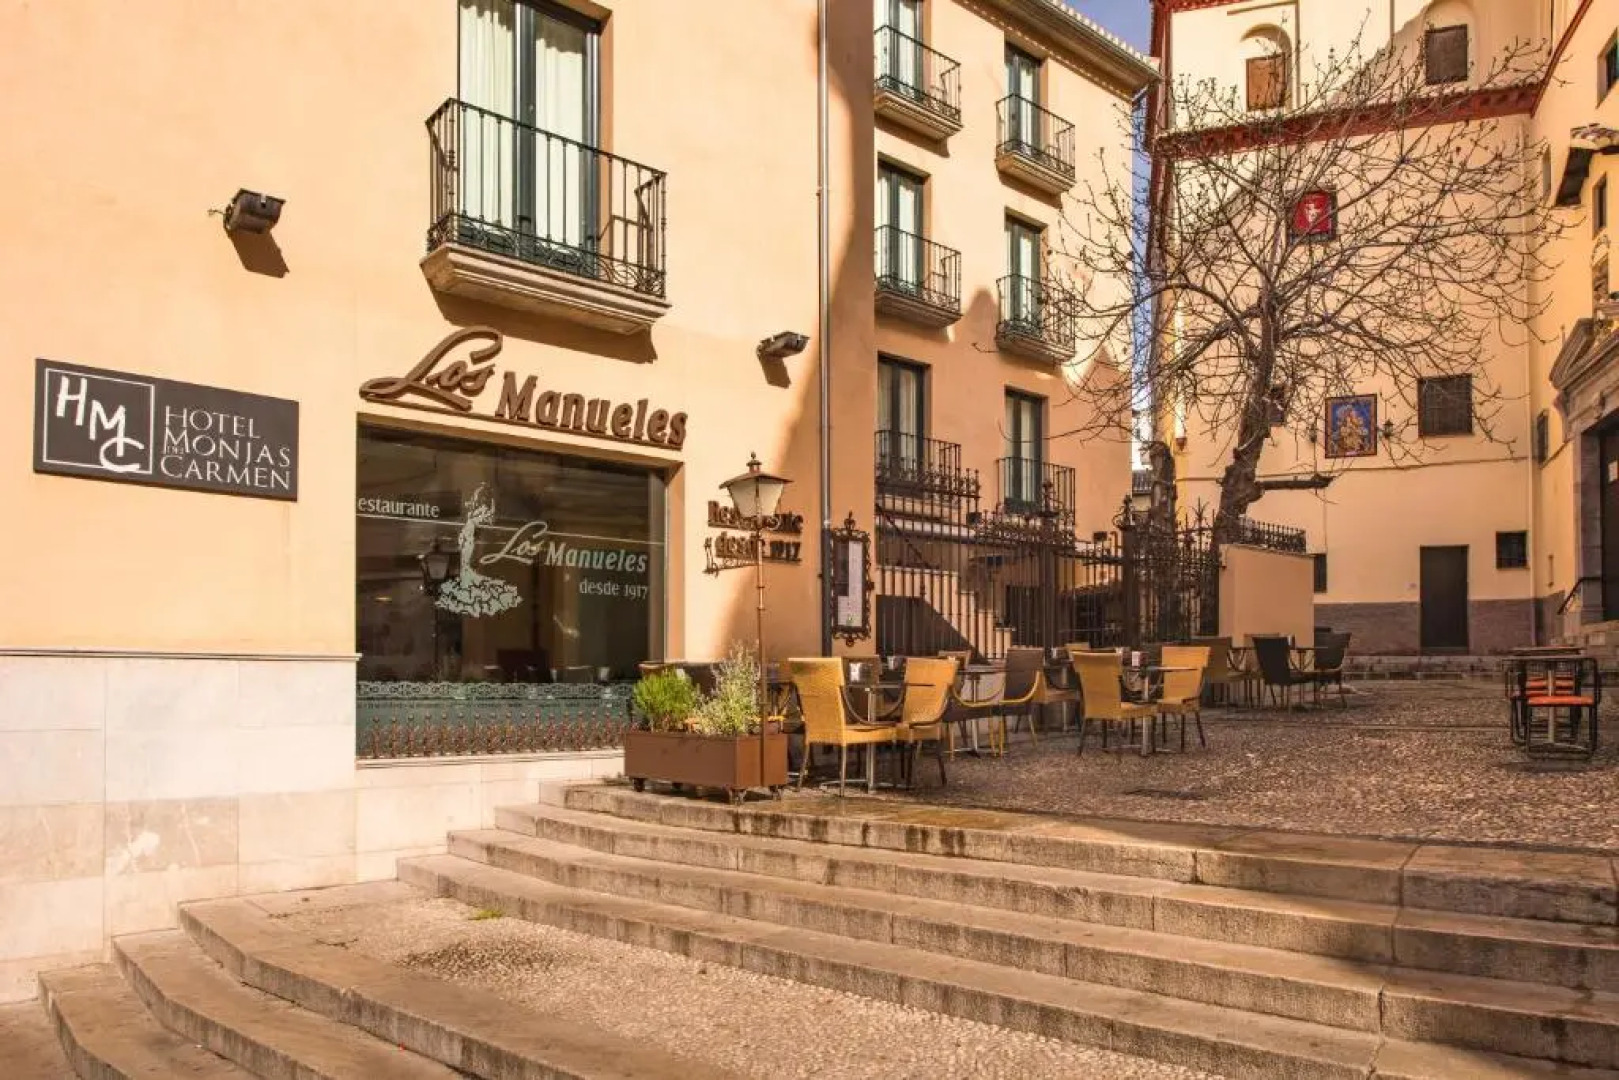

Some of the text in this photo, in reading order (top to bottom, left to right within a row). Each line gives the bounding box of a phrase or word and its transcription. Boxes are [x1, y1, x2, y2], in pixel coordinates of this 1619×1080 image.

[359, 325, 688, 446] Los Manueles
[56, 375, 145, 473] HMC
[165, 405, 261, 438] HOTEL
[163, 426, 291, 468] MONJAS
[160, 454, 291, 490] CARMEN
[358, 497, 440, 518] estaurante
[480, 521, 648, 573] Los Manueles
[579, 578, 648, 600] desde 1917
